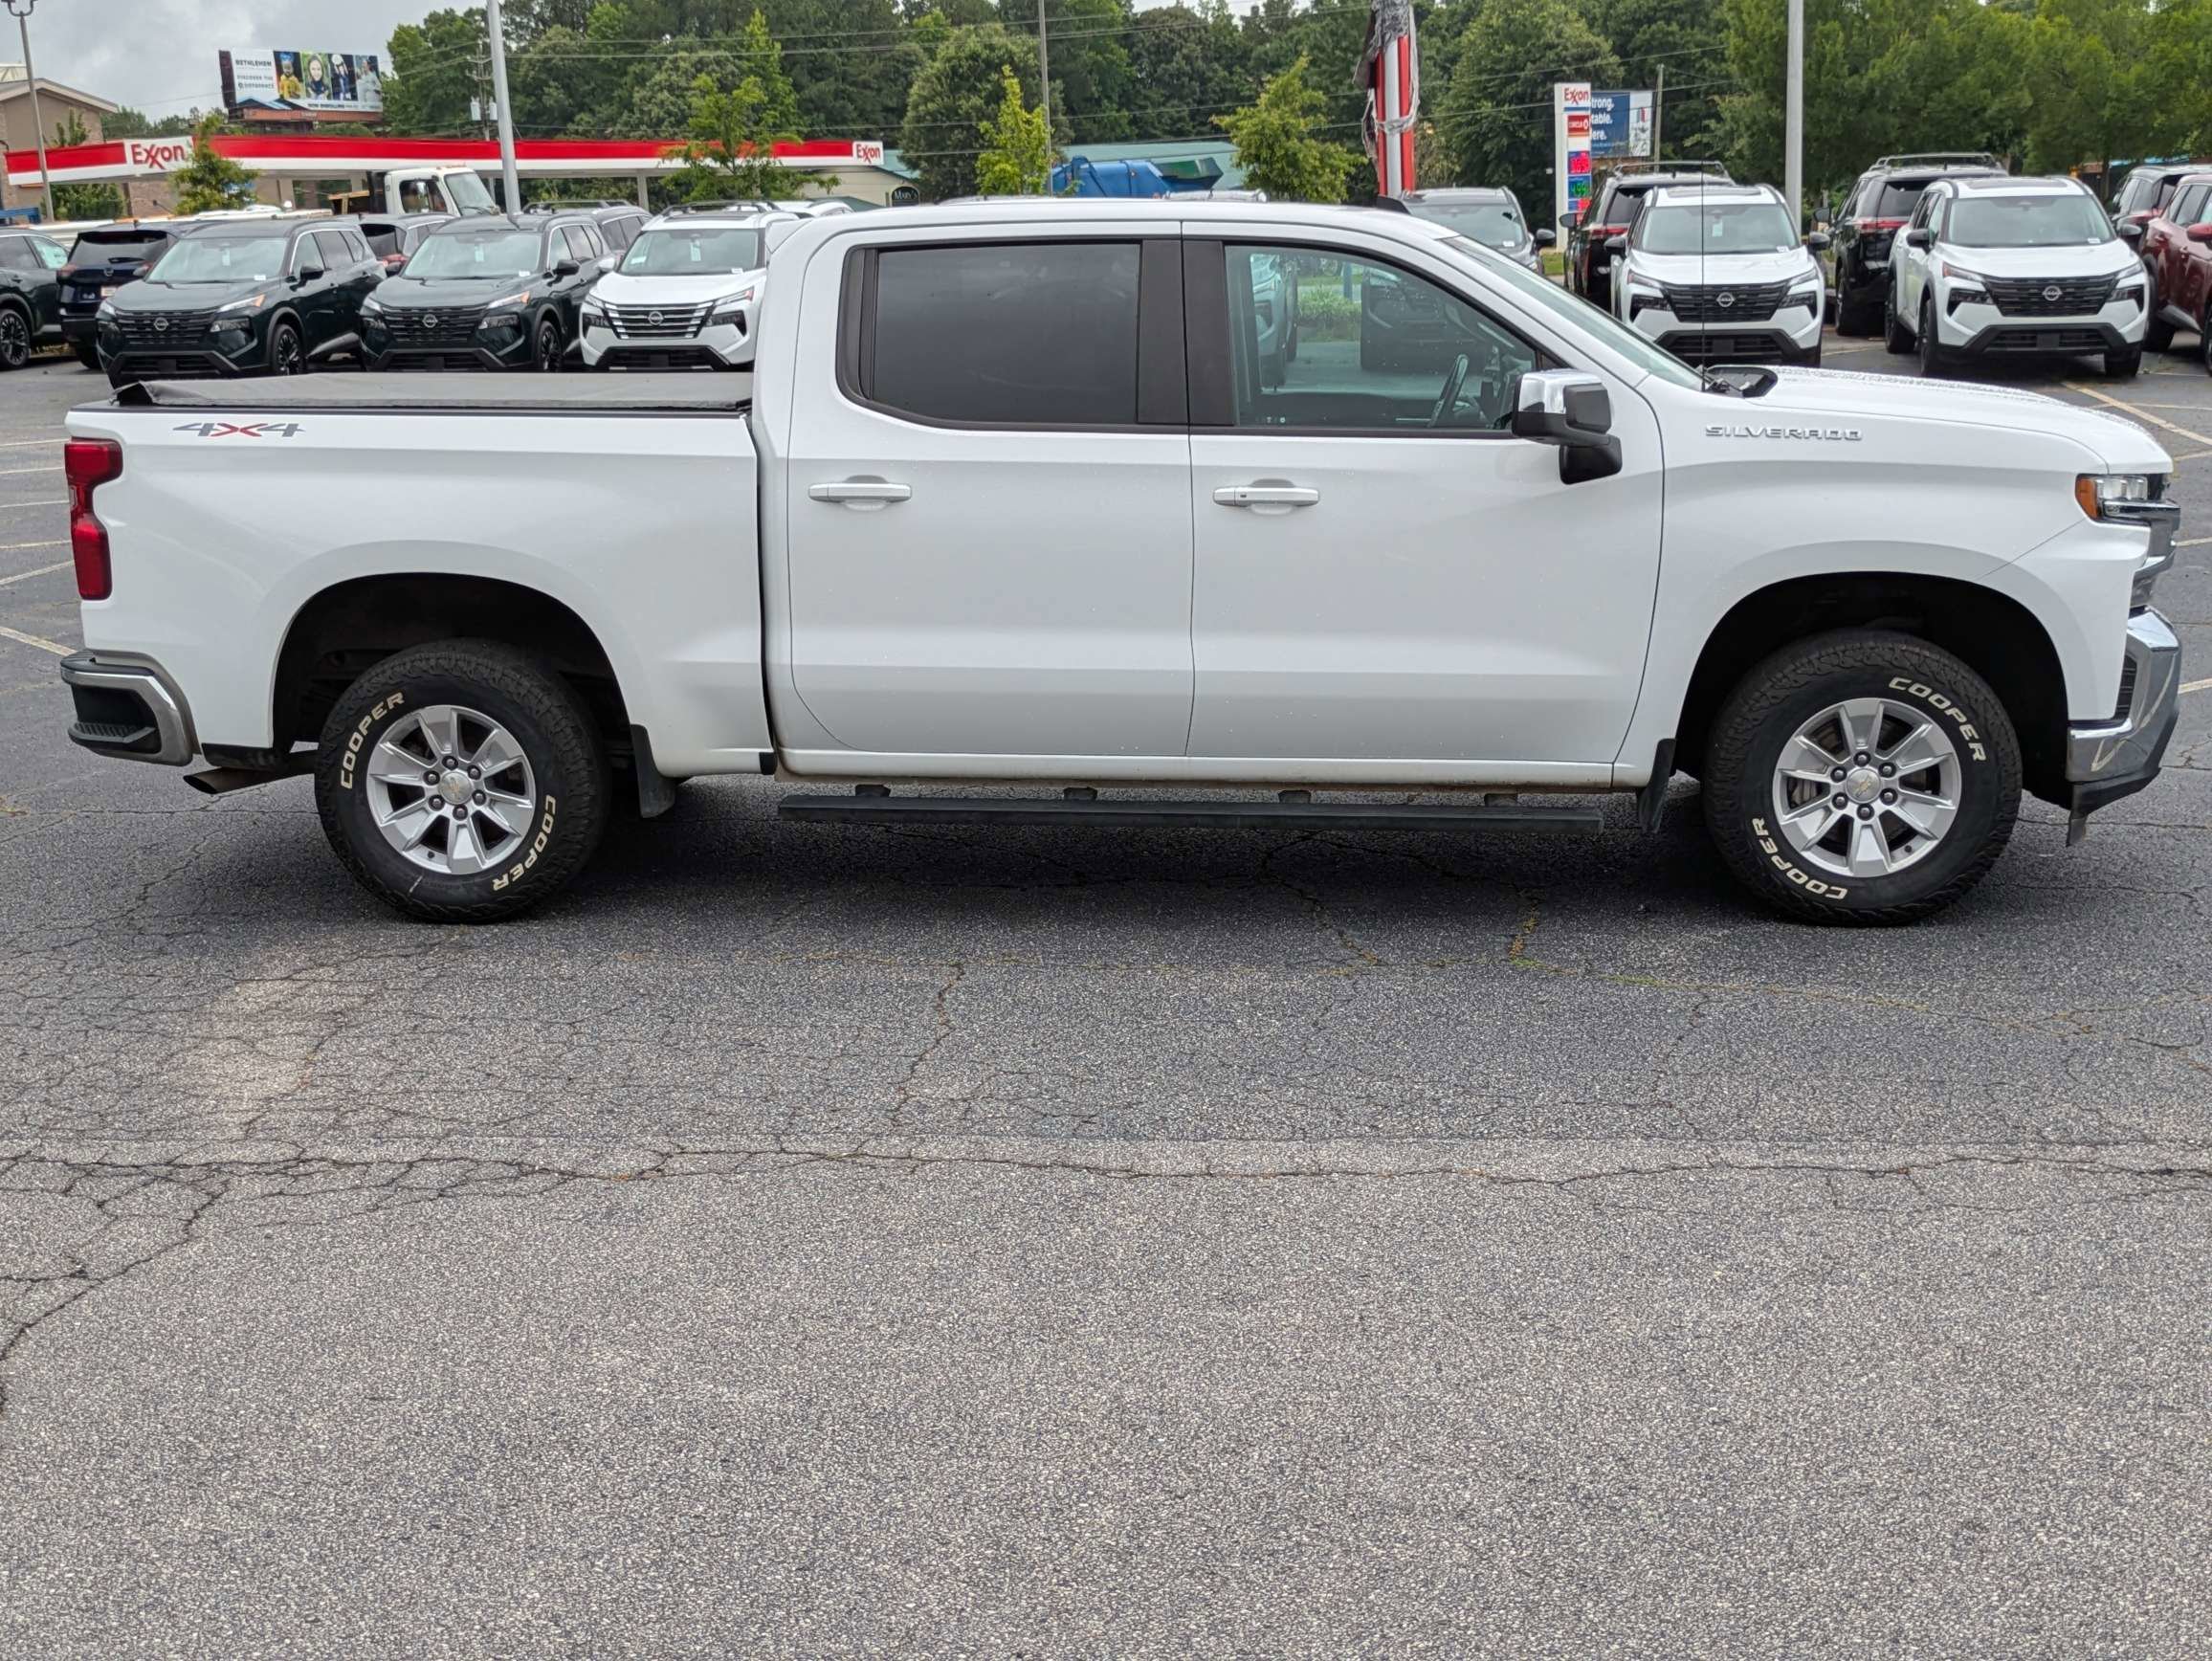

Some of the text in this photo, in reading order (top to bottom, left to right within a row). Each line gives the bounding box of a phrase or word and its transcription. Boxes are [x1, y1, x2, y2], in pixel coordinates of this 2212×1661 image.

[1563, 87, 1588, 105] Exxon
[1591, 112, 1613, 124] table.
[1592, 129, 1607, 141] ere.
[130, 143, 186, 170] Exxon
[855, 144, 881, 165] Exxon
[1705, 424, 1863, 442] SILVERADO
[1888, 675, 1987, 762] COOPER
[341, 691, 406, 789] COOPER
[492, 795, 557, 892] COOPER
[1751, 816, 1848, 900] COOPER
